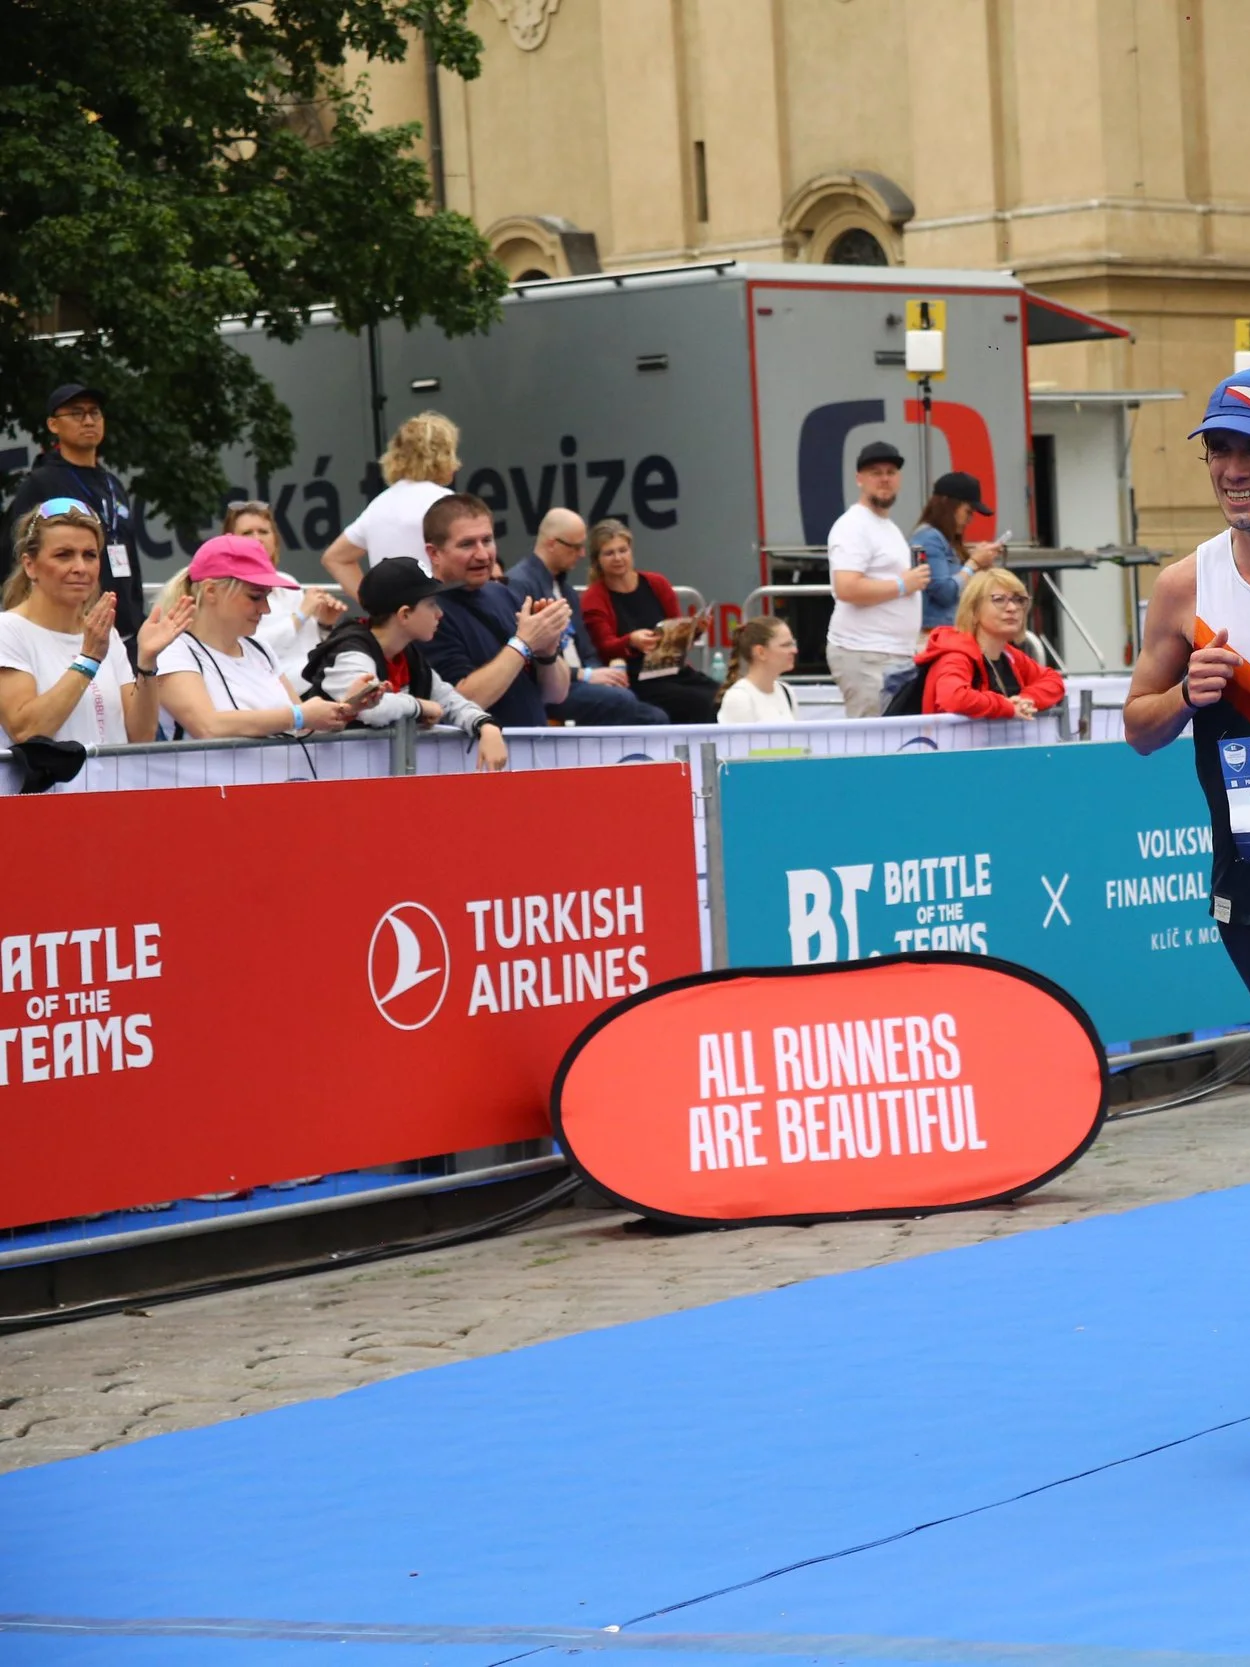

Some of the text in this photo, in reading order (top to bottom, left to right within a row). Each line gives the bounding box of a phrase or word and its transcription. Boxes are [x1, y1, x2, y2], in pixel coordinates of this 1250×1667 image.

[884, 853, 992, 905] BATTLE
[1106, 872, 1208, 909] FINANCIAL
[466, 885, 644, 951] TURKISH
[916, 902, 963, 925] OF THE
[1151, 927, 1180, 951] KLÍČ
[1185, 929, 1193, 946] K
[26, 989, 111, 1020] OF THE
[467, 945, 648, 1016] AIRLINES
[0, 1013, 154, 1086] TEAMS
[698, 1012, 962, 1100] ALL RUNNERS
[688, 1084, 988, 1173] ARE BEAUTIFUL
